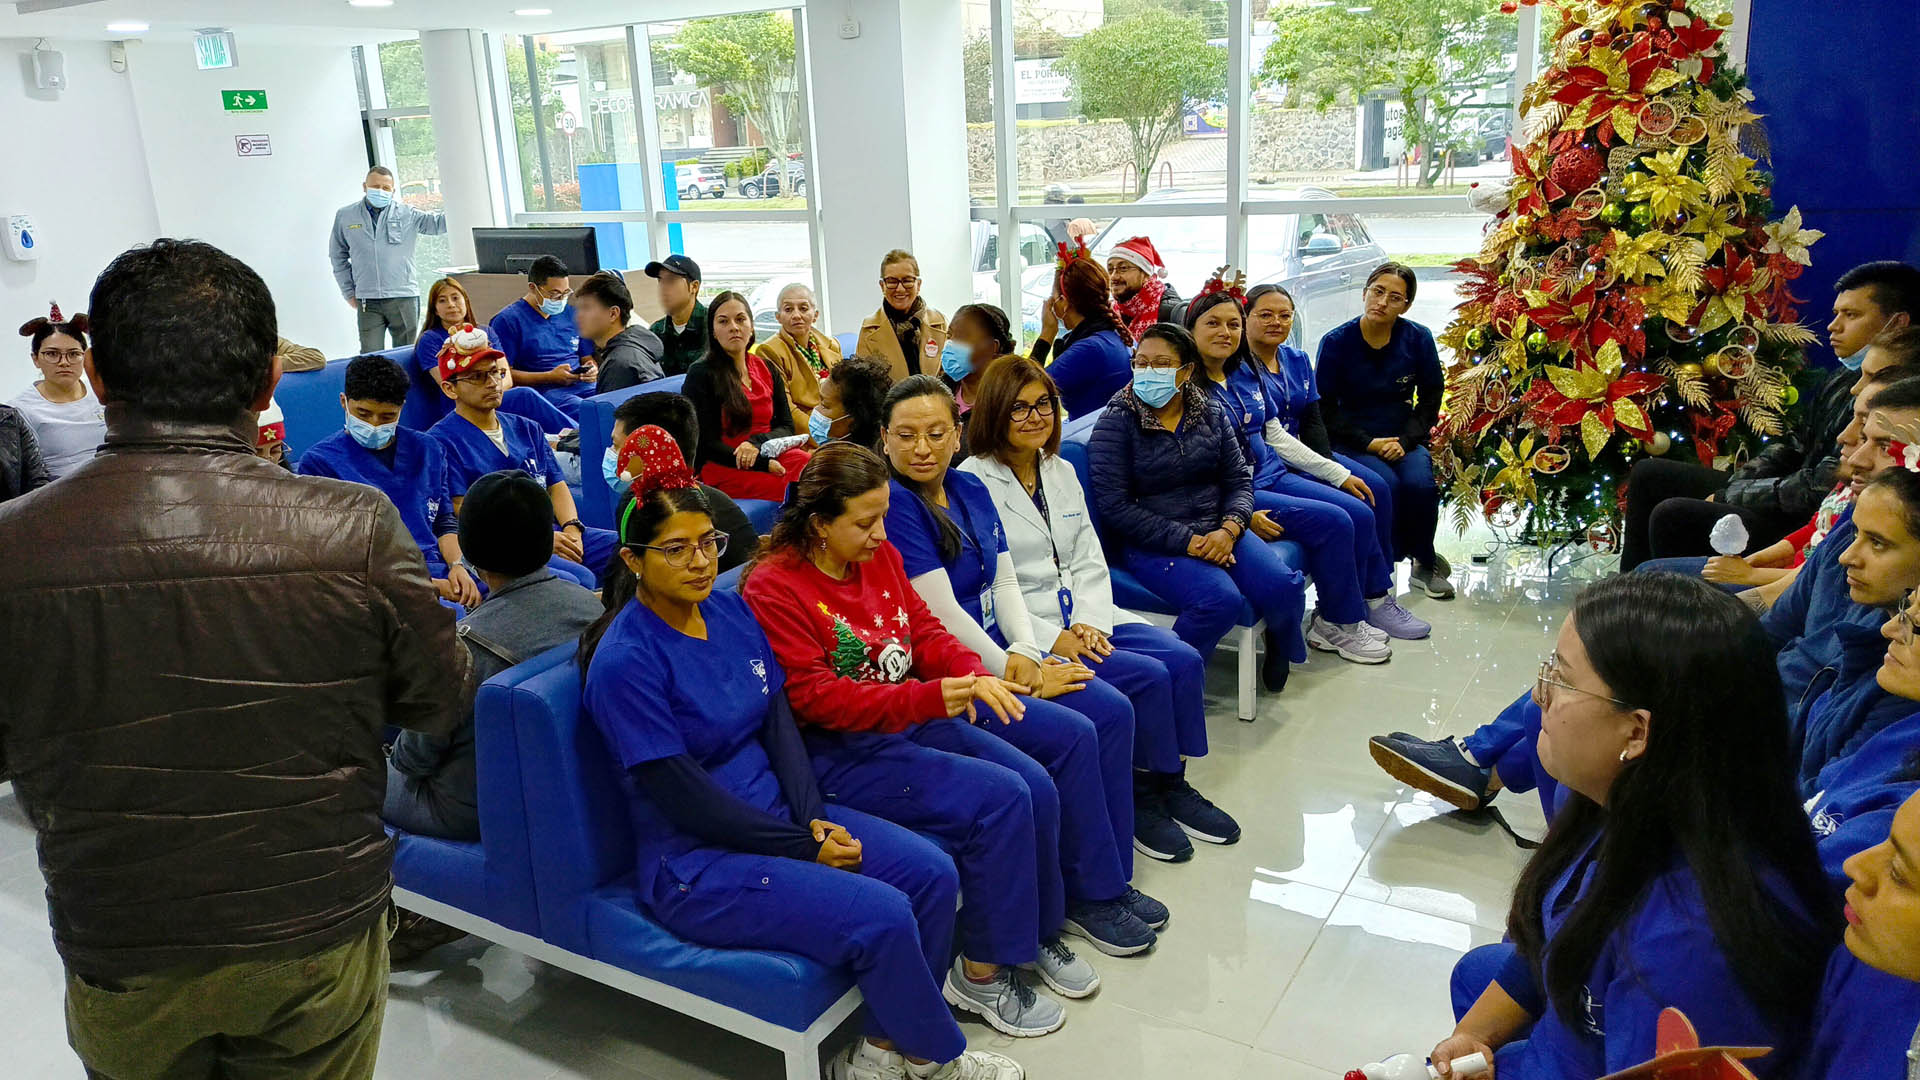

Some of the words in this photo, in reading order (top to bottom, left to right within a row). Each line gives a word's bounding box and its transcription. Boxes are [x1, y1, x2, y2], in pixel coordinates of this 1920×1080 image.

[197, 35, 228, 66] SALIDA
[1021, 70, 1032, 80] EL
[1385, 107, 1405, 121] utos
[565, 118, 574, 129] 30
